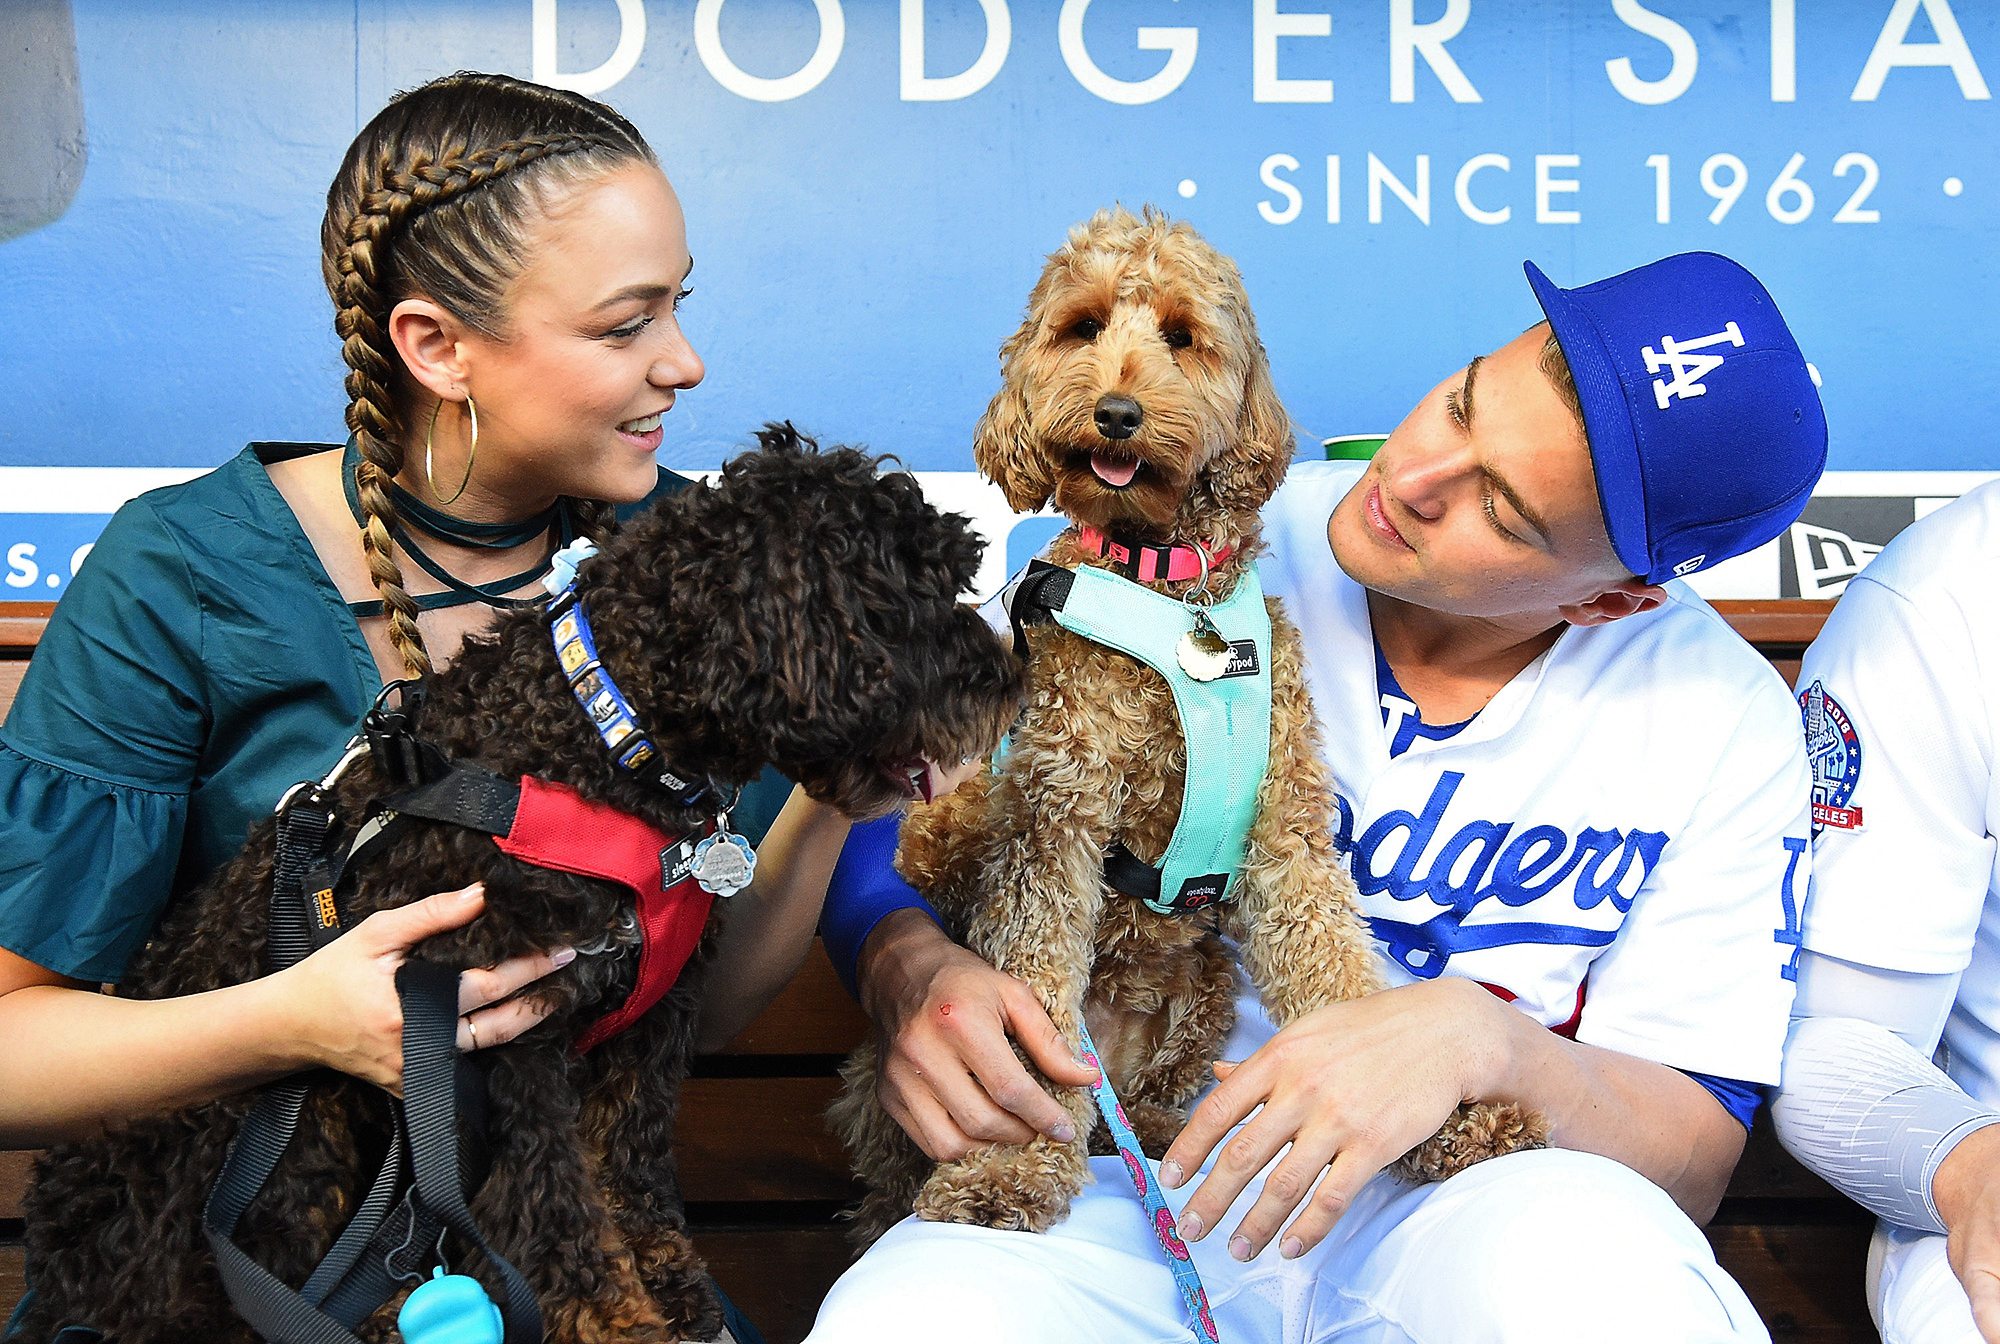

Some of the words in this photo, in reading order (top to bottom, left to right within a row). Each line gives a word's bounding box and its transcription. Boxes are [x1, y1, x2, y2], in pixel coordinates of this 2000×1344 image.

[531, 0, 1483, 104] DODGER
[1257, 152, 1581, 225] SINCE
[1646, 152, 1880, 225] 1962
[1641, 321, 1745, 410] LA
[1227, 655, 1253, 673] pypod
[1825, 700, 1851, 735] 2018
[1813, 806, 1849, 825] GELES
[671, 856, 694, 879] sleep
[1335, 770, 1671, 979] dgers
